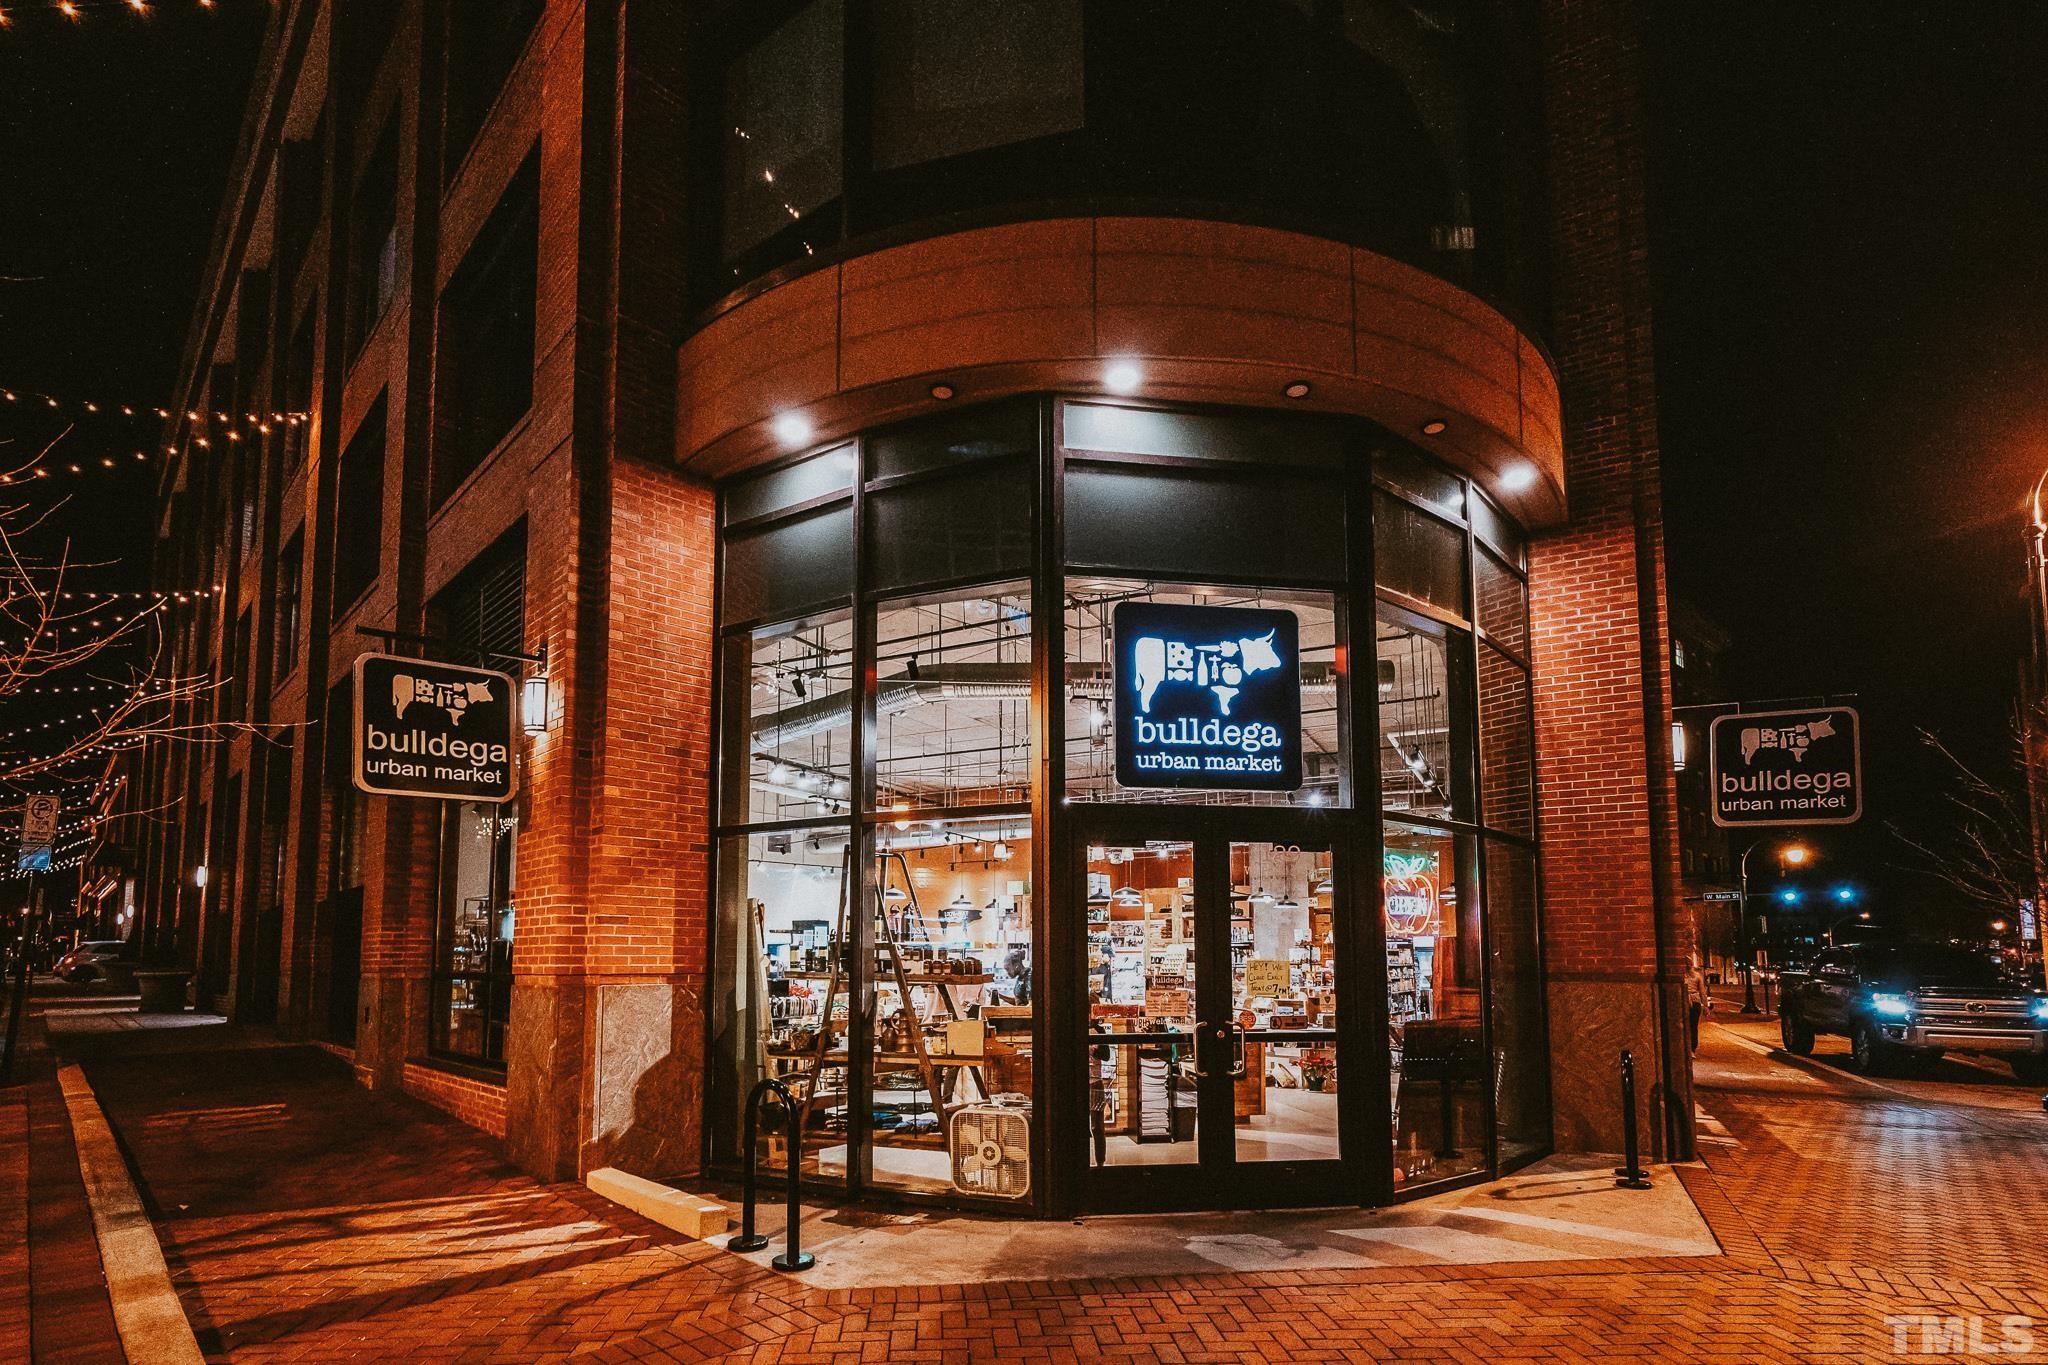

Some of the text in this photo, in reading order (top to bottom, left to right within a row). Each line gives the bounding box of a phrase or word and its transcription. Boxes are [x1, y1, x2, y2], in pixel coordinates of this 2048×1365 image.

[368, 724, 507, 766] bulldega
[1135, 716, 1281, 752] bulldega
[367, 759, 502, 784] urban market
[1136, 752, 1282, 771] urban market
[1722, 770, 1851, 794] bulldega
[1721, 795, 1846, 812] urban market
